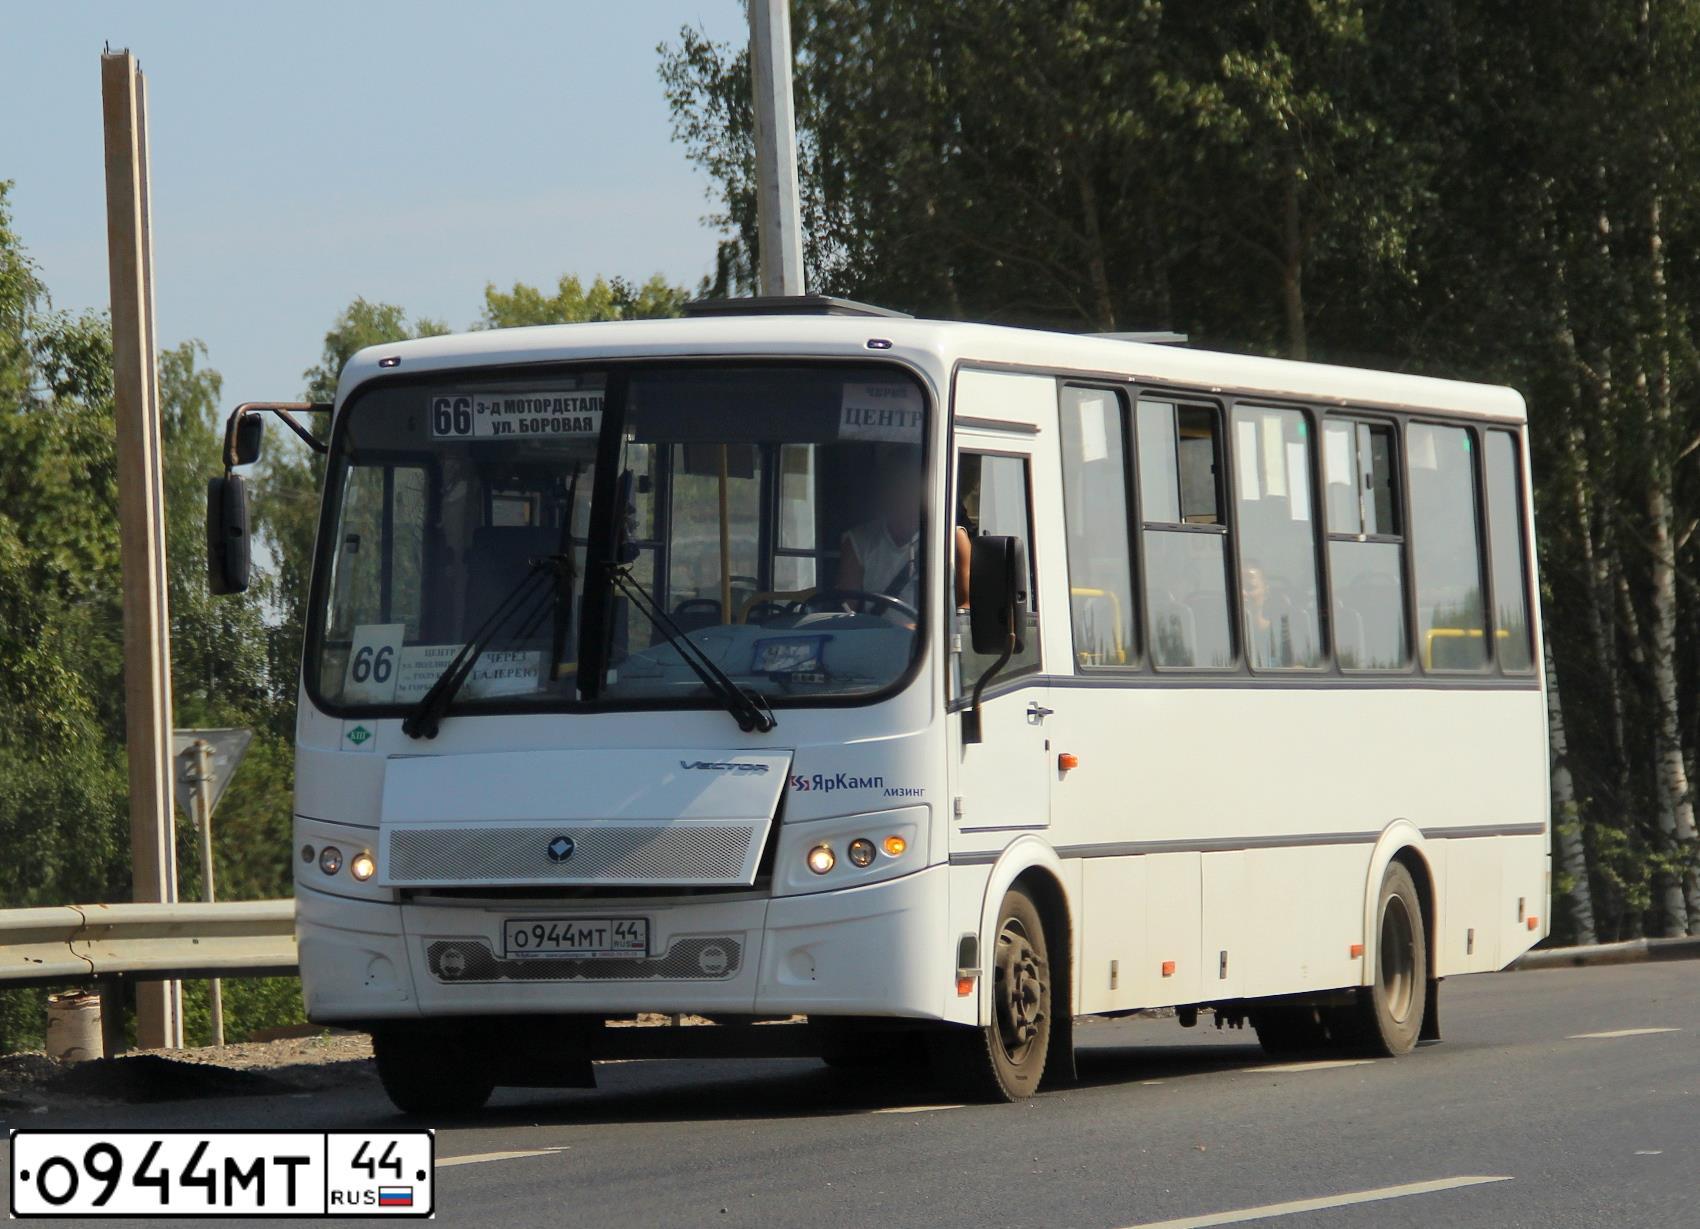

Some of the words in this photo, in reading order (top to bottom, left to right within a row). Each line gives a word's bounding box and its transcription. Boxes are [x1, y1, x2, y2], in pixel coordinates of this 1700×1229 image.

[433, 398, 471, 435] 66
[844, 408, 923, 428] ЦЕНТР
[492, 420, 516, 435] ул.
[518, 417, 593, 433] БОРОВАЯ
[352, 645, 394, 683] 66
[487, 651, 527, 664] ЧЕРЕЗ
[680, 760, 769, 772] VECTOR
[812, 773, 884, 793] ЯрКамп
[883, 786, 926, 797] лизинг
[615, 922, 638, 940] 44
